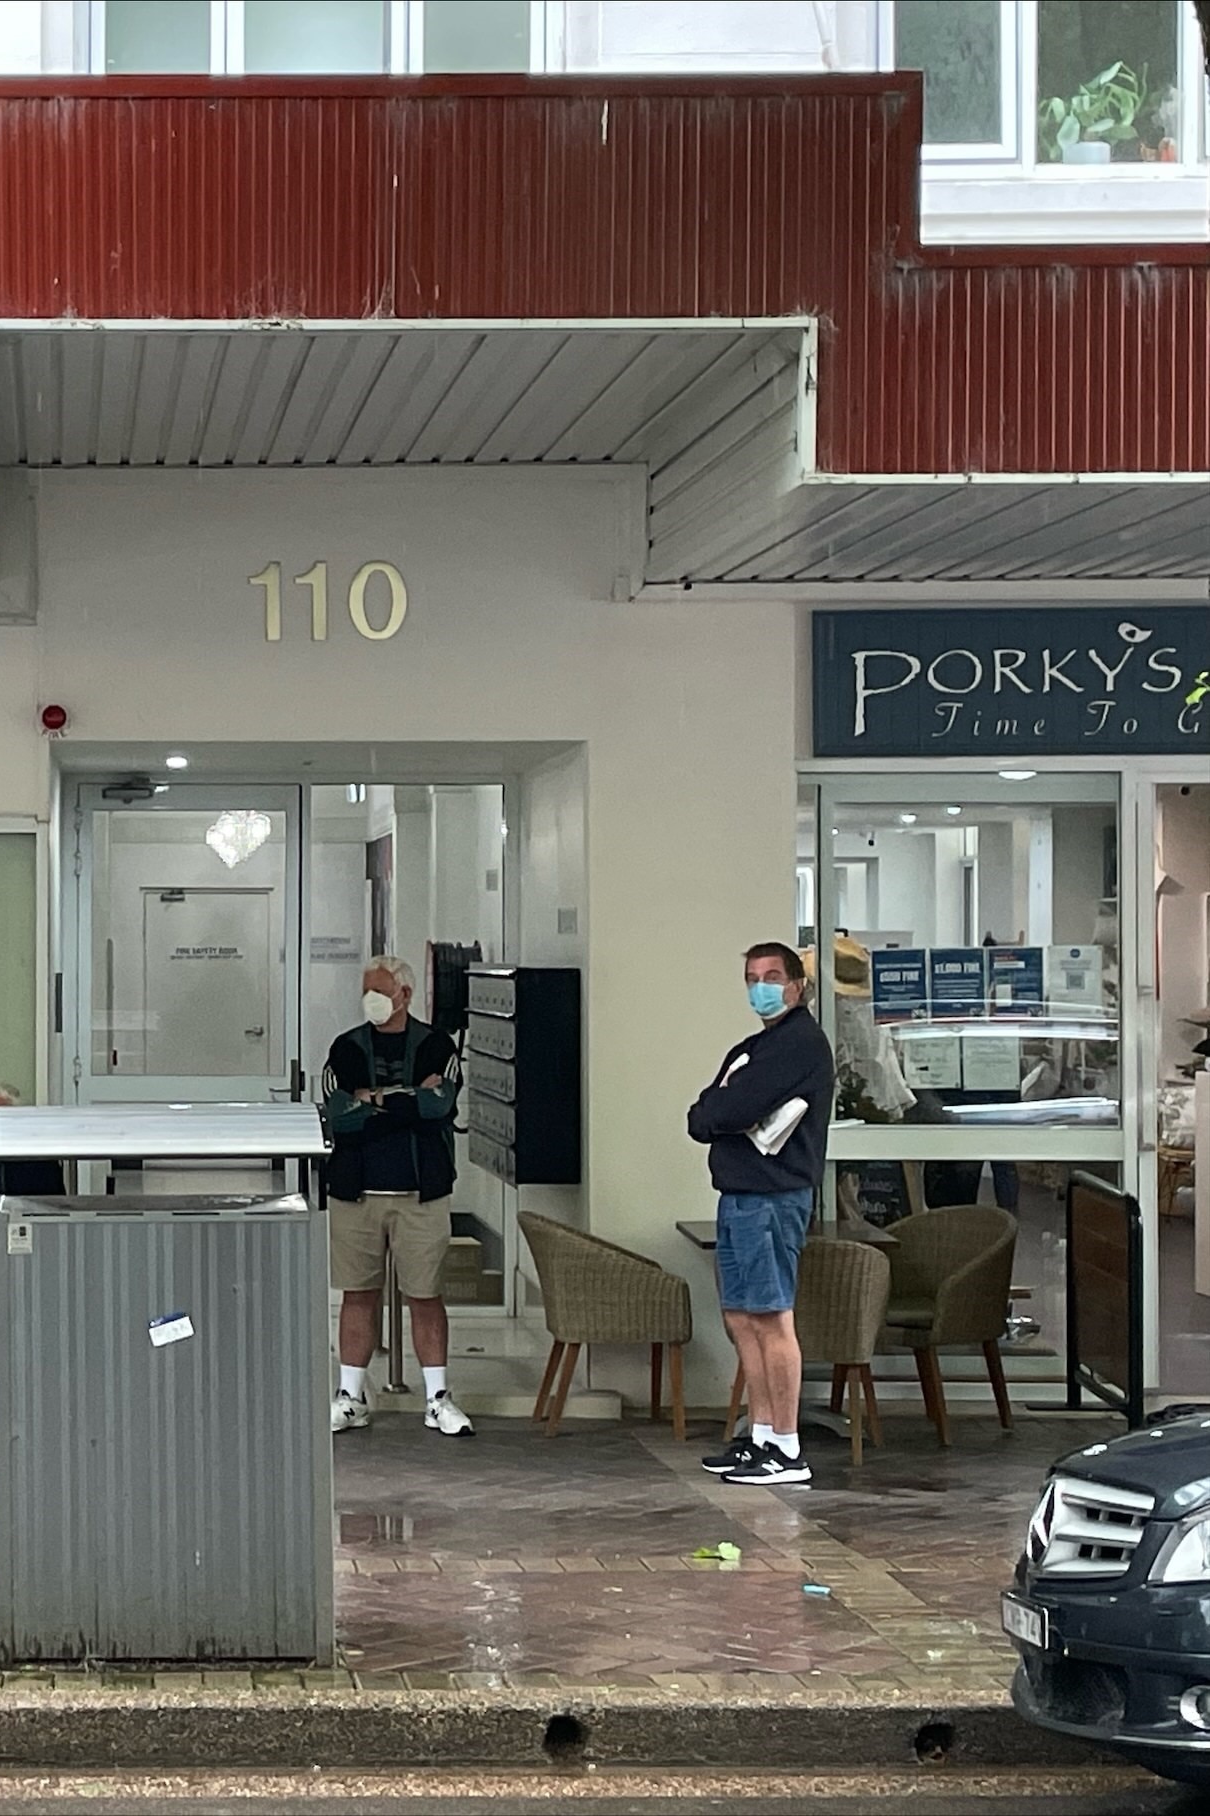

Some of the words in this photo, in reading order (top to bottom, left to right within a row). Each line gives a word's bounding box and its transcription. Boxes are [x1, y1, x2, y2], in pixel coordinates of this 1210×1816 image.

[248, 560, 408, 641] 110
[932, 702, 1047, 737] Time
[1084, 700, 1138, 736] To
